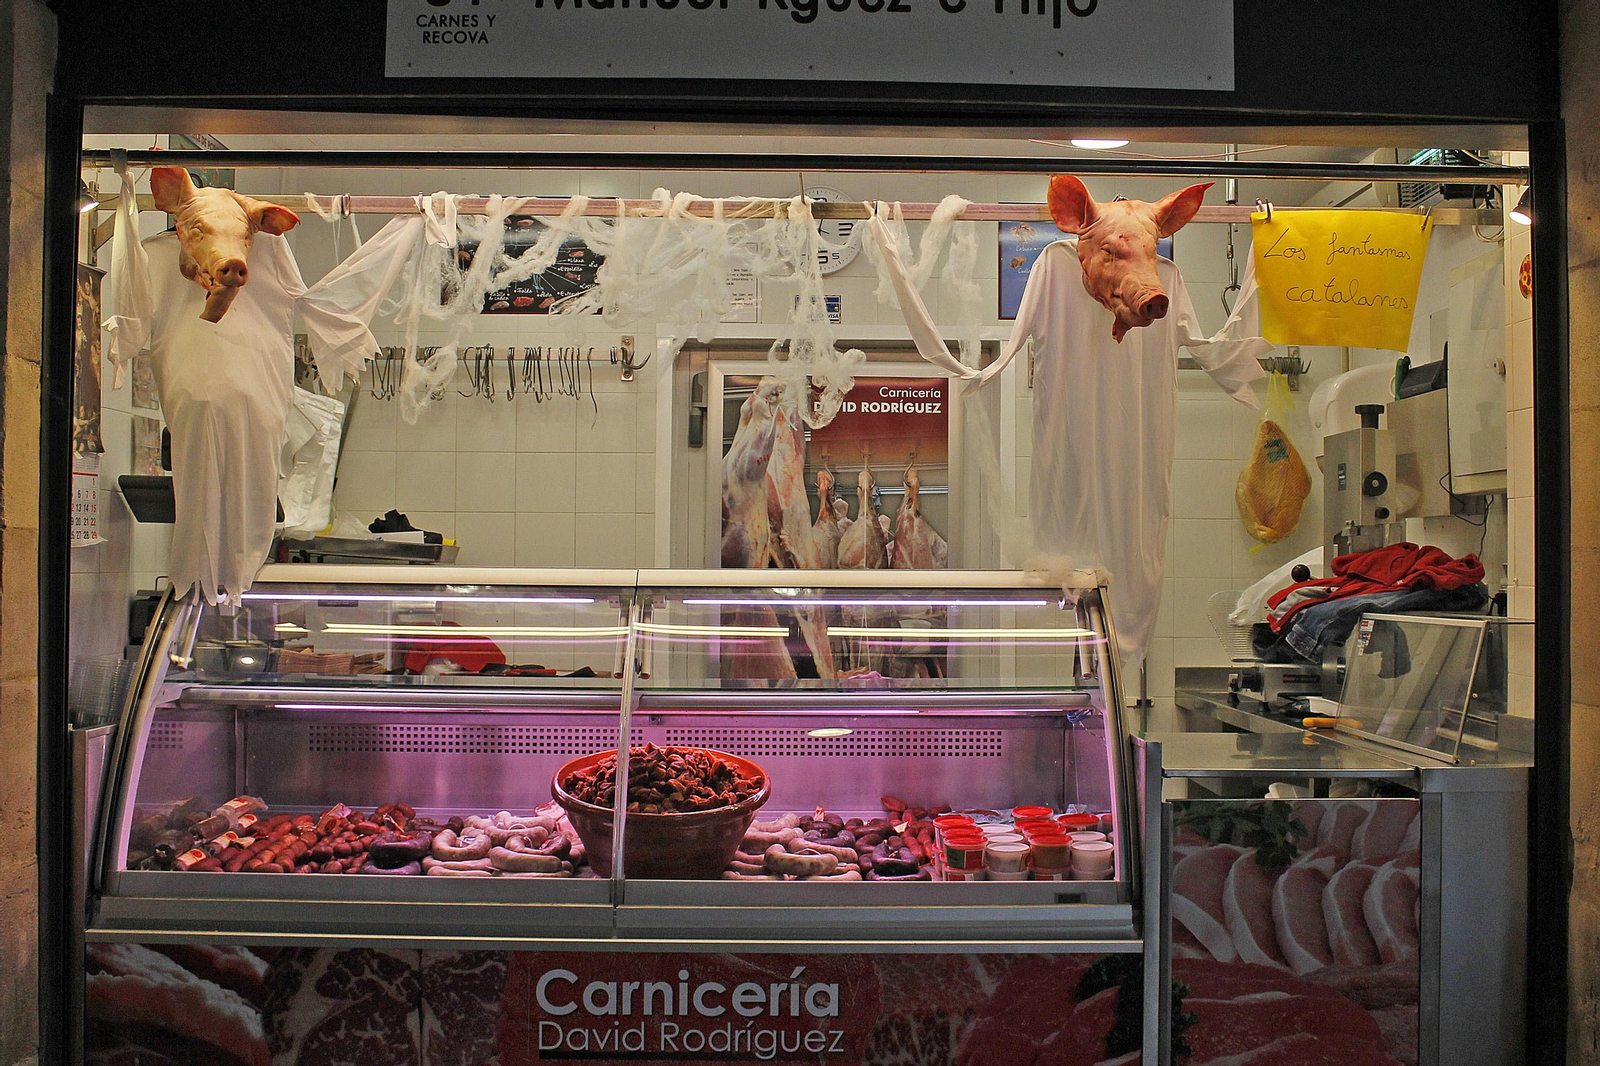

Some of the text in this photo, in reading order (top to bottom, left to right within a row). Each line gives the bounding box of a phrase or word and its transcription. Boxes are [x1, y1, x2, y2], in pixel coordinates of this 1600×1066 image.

[415, 14, 497, 28] CARNES Y
[422, 30, 489, 44] RECOVA
[1263, 227, 1411, 266] Los fantasmas
[879, 386, 942, 399] Carnicería
[814, 399, 942, 414] DID RODRÍGUEZ
[76, 503, 82, 512] 13
[83, 503, 89, 513] 14
[91, 504, 97, 513] 15
[83, 517, 89, 526] 21
[535, 966, 841, 1018] Carnicería
[538, 1020, 846, 1059] David Rodríguez
